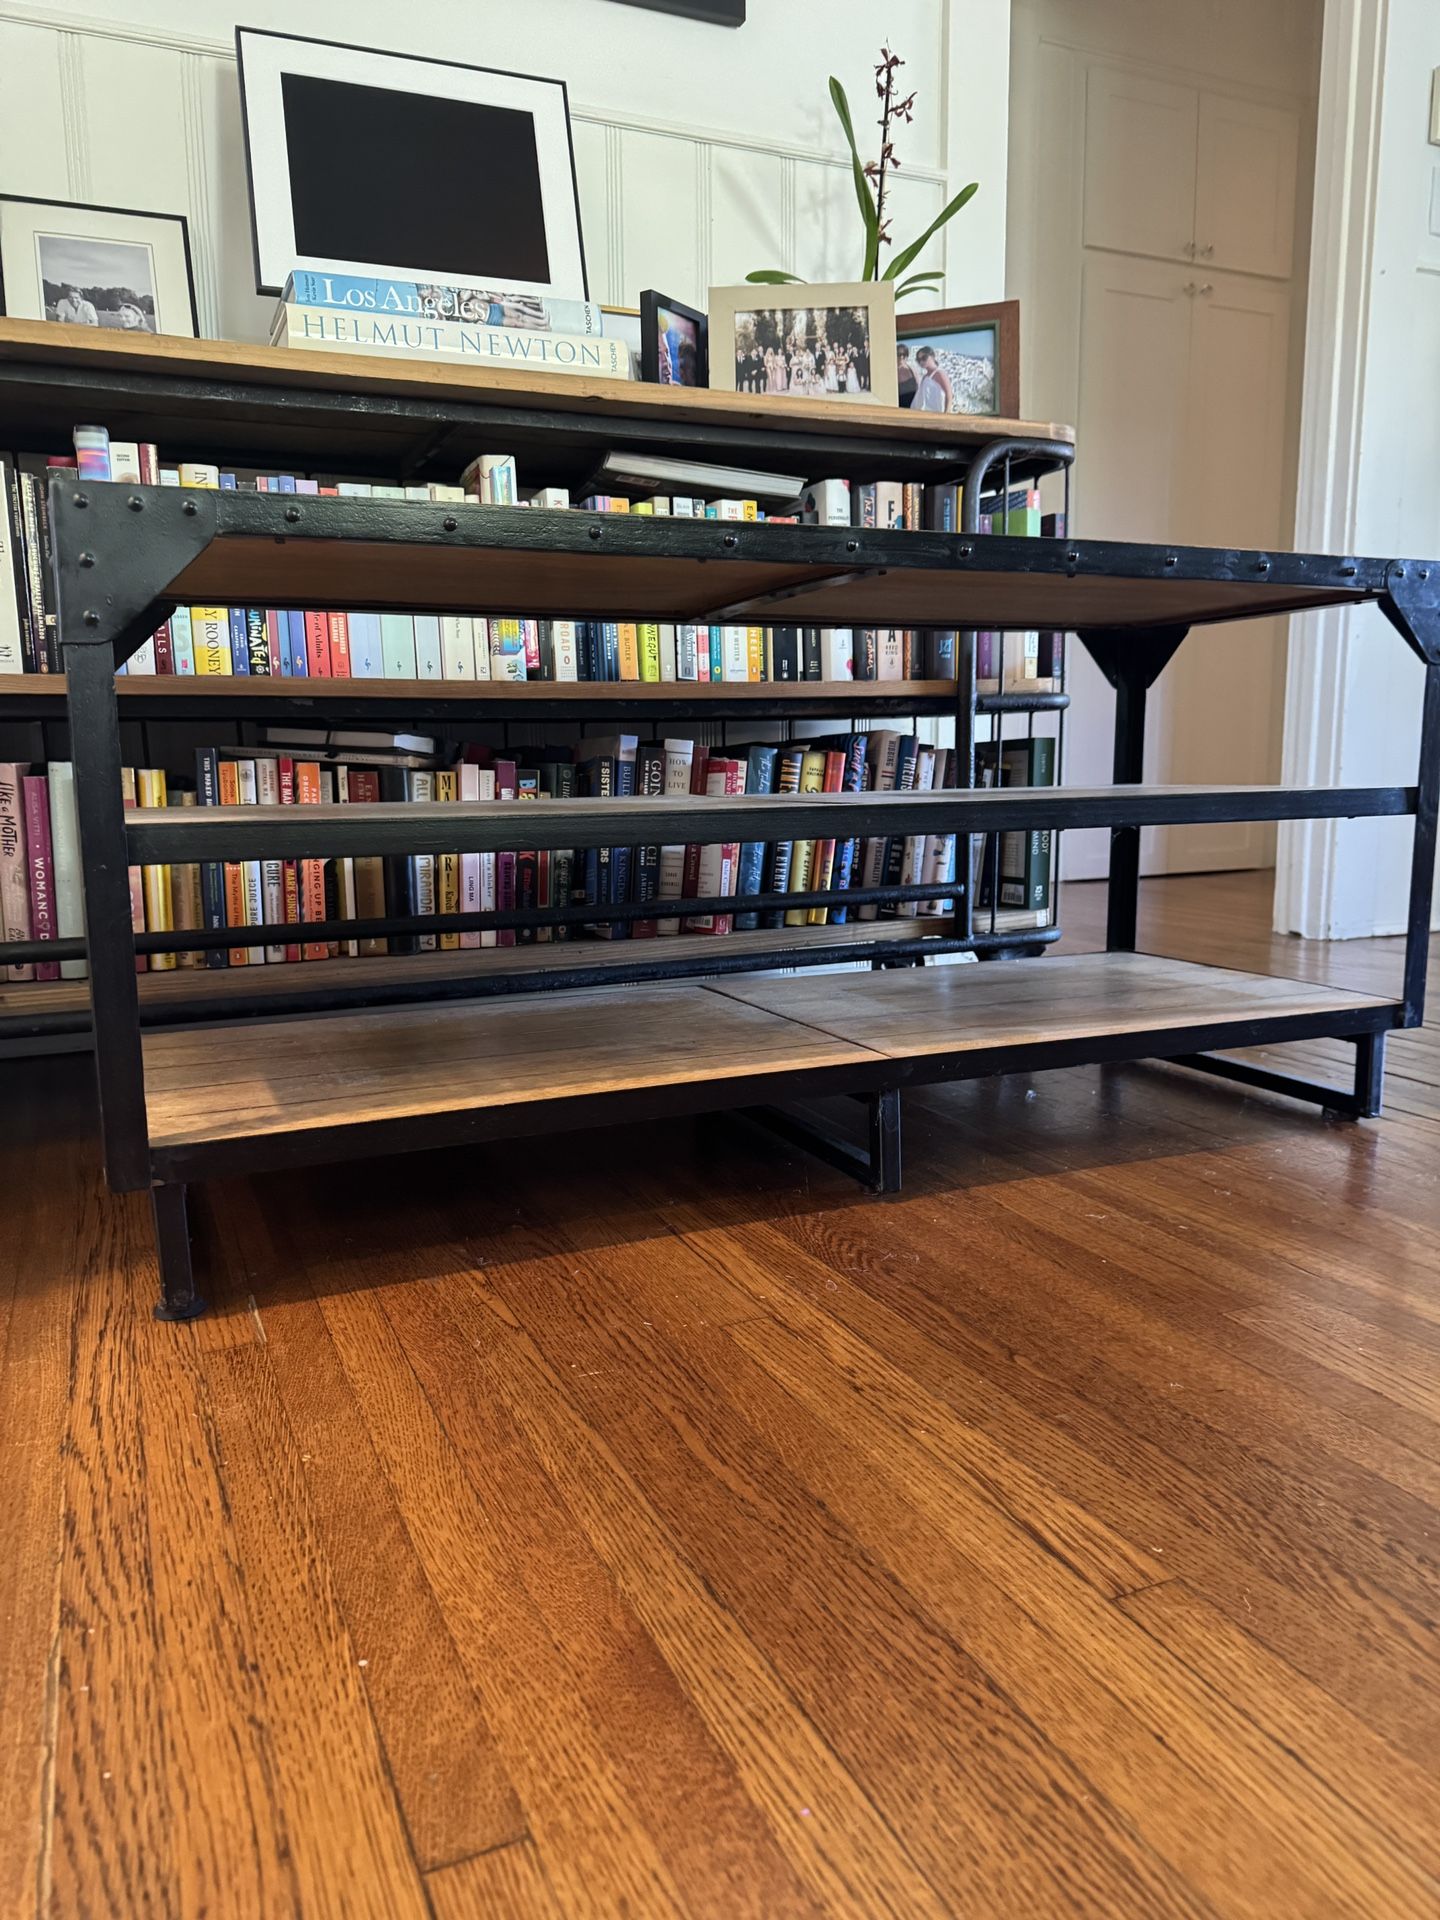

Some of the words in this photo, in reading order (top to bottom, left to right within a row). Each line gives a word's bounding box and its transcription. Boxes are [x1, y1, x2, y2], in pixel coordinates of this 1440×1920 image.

[323, 278, 377, 308] Los
[381, 285, 488, 320] Angeles
[303, 314, 444, 350] HELMUT
[460, 330, 601, 367] NEWTON
[205, 622, 221, 675] ROONEY
[315, 634, 324, 658] Adults
[559, 623, 570, 652] ROAD
[624, 638, 632, 661] BUTLER
[669, 758, 687, 766] HOW
[760, 756, 771, 769] The
[850, 741, 865, 771] Such
[204, 773, 212, 797] NAKED
[282, 772, 290, 786] THE
[672, 769, 683, 777] TO
[758, 769, 769, 791] Index
[780, 759, 801, 793] JAMES
[416, 778, 428, 799] ALL
[31, 792, 39, 814] ALISA
[1, 815, 18, 857] MOTHER
[32, 816, 40, 836] VITTI
[1032, 831, 1040, 855] MIND
[646, 846, 657, 866] CH
[872, 842, 884, 882] PERSONALITY
[265, 862, 280, 888] CURE
[286, 868, 296, 888] MARK
[419, 857, 433, 913] MIRANDA
[802, 860, 810, 887] LITTLE
[248, 878, 257, 904] JUICE
[314, 893, 321, 906] UP
[469, 892, 475, 902] MA
[250, 907, 258, 927] PURE
